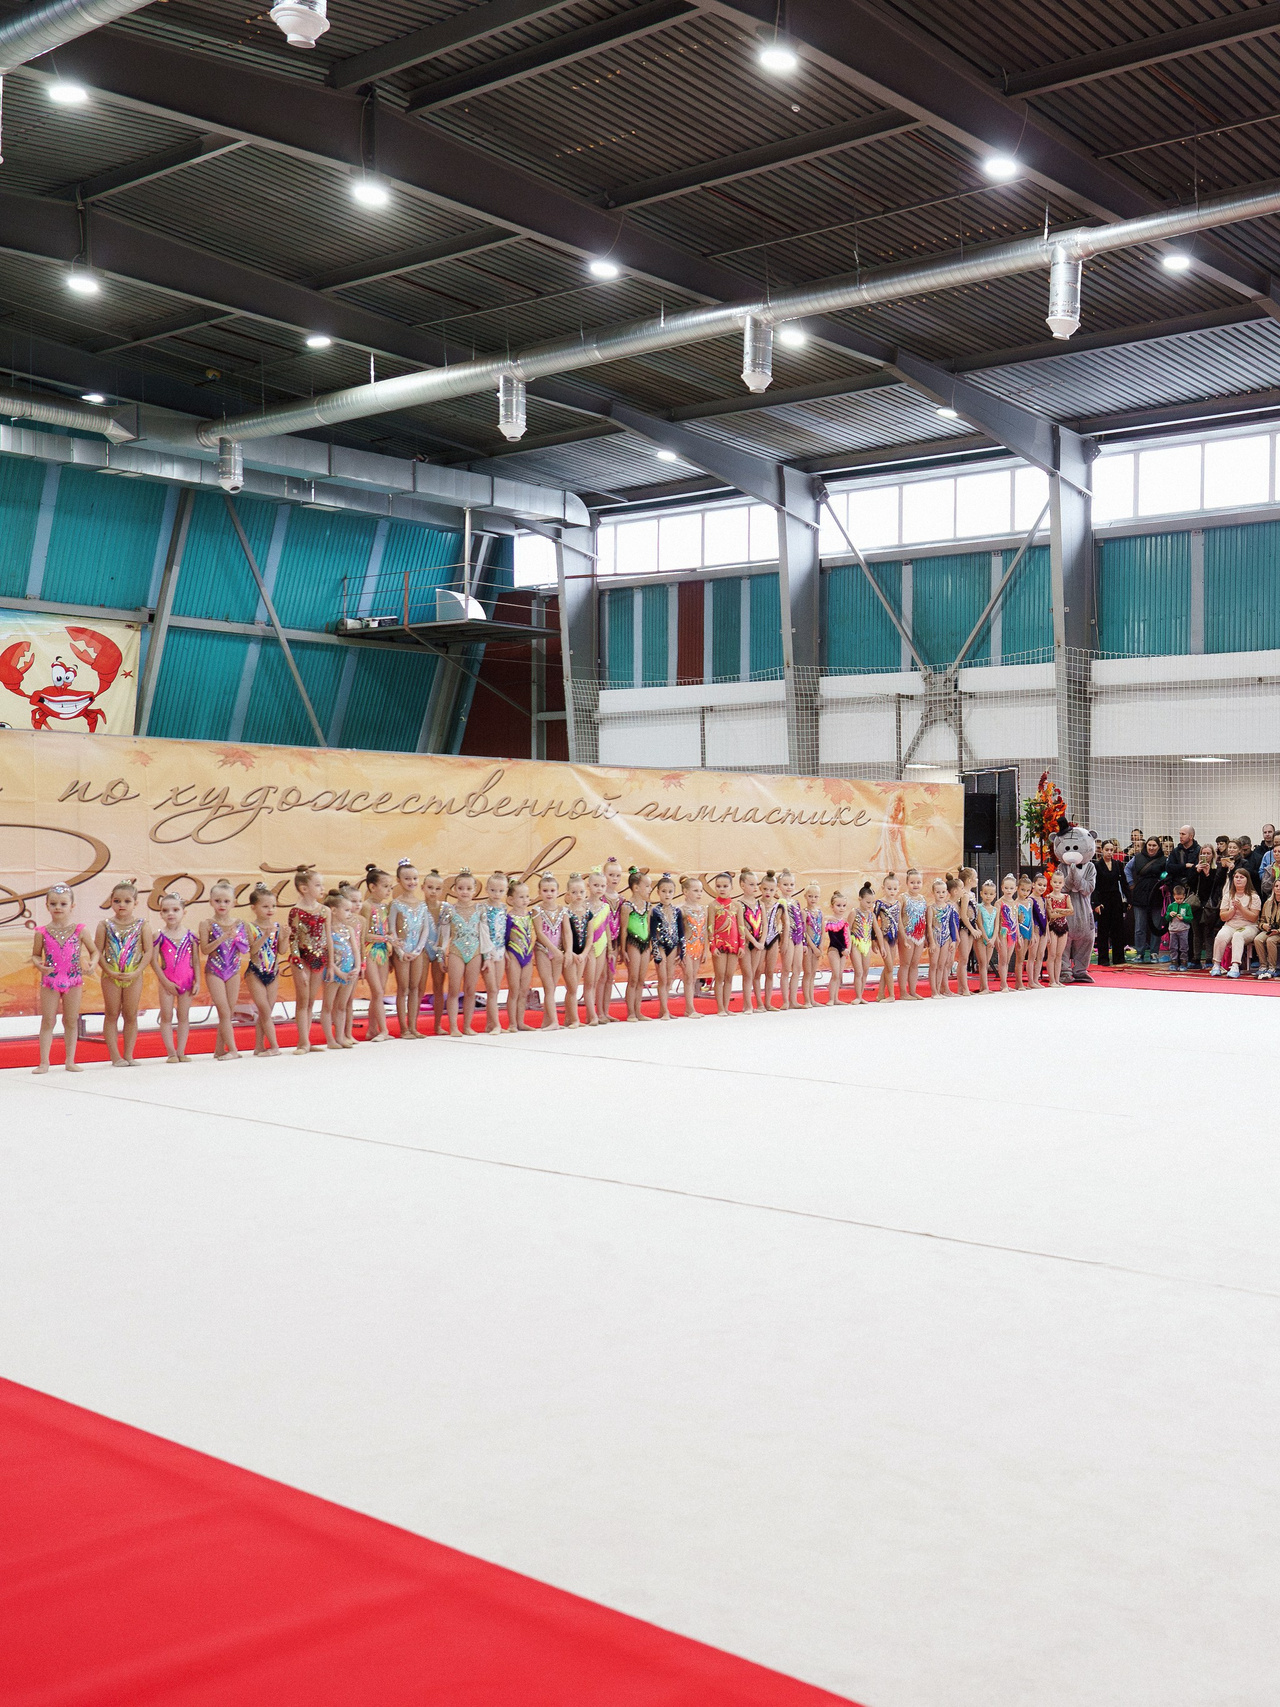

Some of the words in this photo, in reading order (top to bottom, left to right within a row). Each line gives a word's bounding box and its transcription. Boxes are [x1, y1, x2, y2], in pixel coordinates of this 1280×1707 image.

[58, 778, 140, 806] по
[149, 768, 622, 845] художественной
[634, 800, 872, 828] гимнастике
